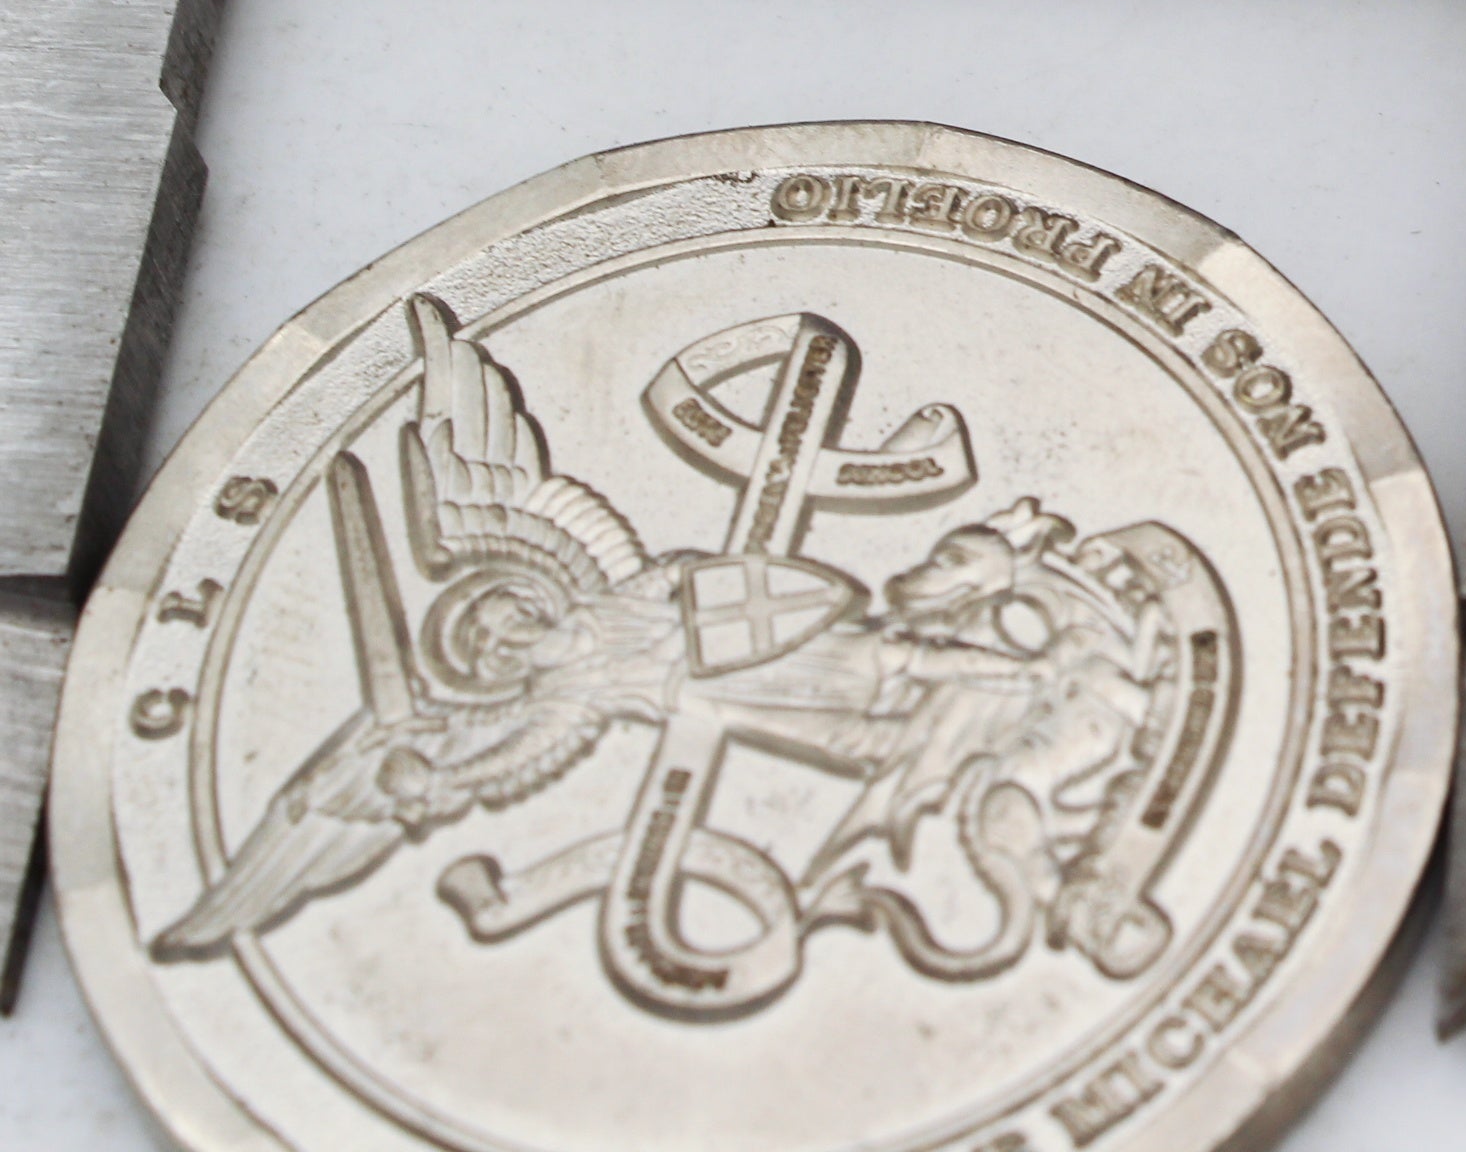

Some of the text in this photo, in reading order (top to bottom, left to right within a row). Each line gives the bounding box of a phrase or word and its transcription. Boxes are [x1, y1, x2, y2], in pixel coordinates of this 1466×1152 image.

[769, 172, 1123, 283] PROELIO
[1113, 263, 1213, 338] IN
[1200, 327, 1327, 462] NOS
[1292, 466, 1386, 818] DEFENDE
[1047, 838, 1343, 1149] MICHAEL
